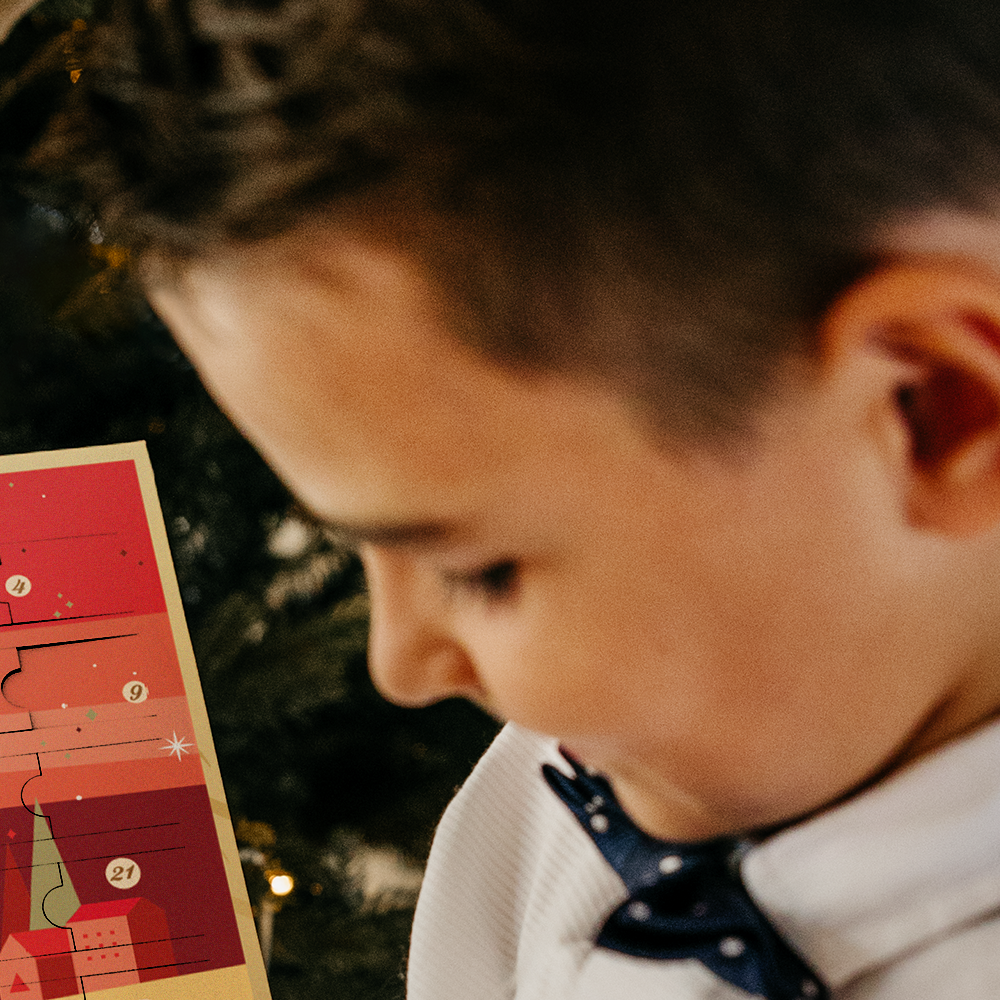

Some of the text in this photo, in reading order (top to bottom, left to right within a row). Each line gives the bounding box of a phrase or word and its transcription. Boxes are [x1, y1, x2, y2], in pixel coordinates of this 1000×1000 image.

[12, 578, 26, 596] 4
[129, 684, 143, 702] 9
[110, 864, 136, 883] 21
